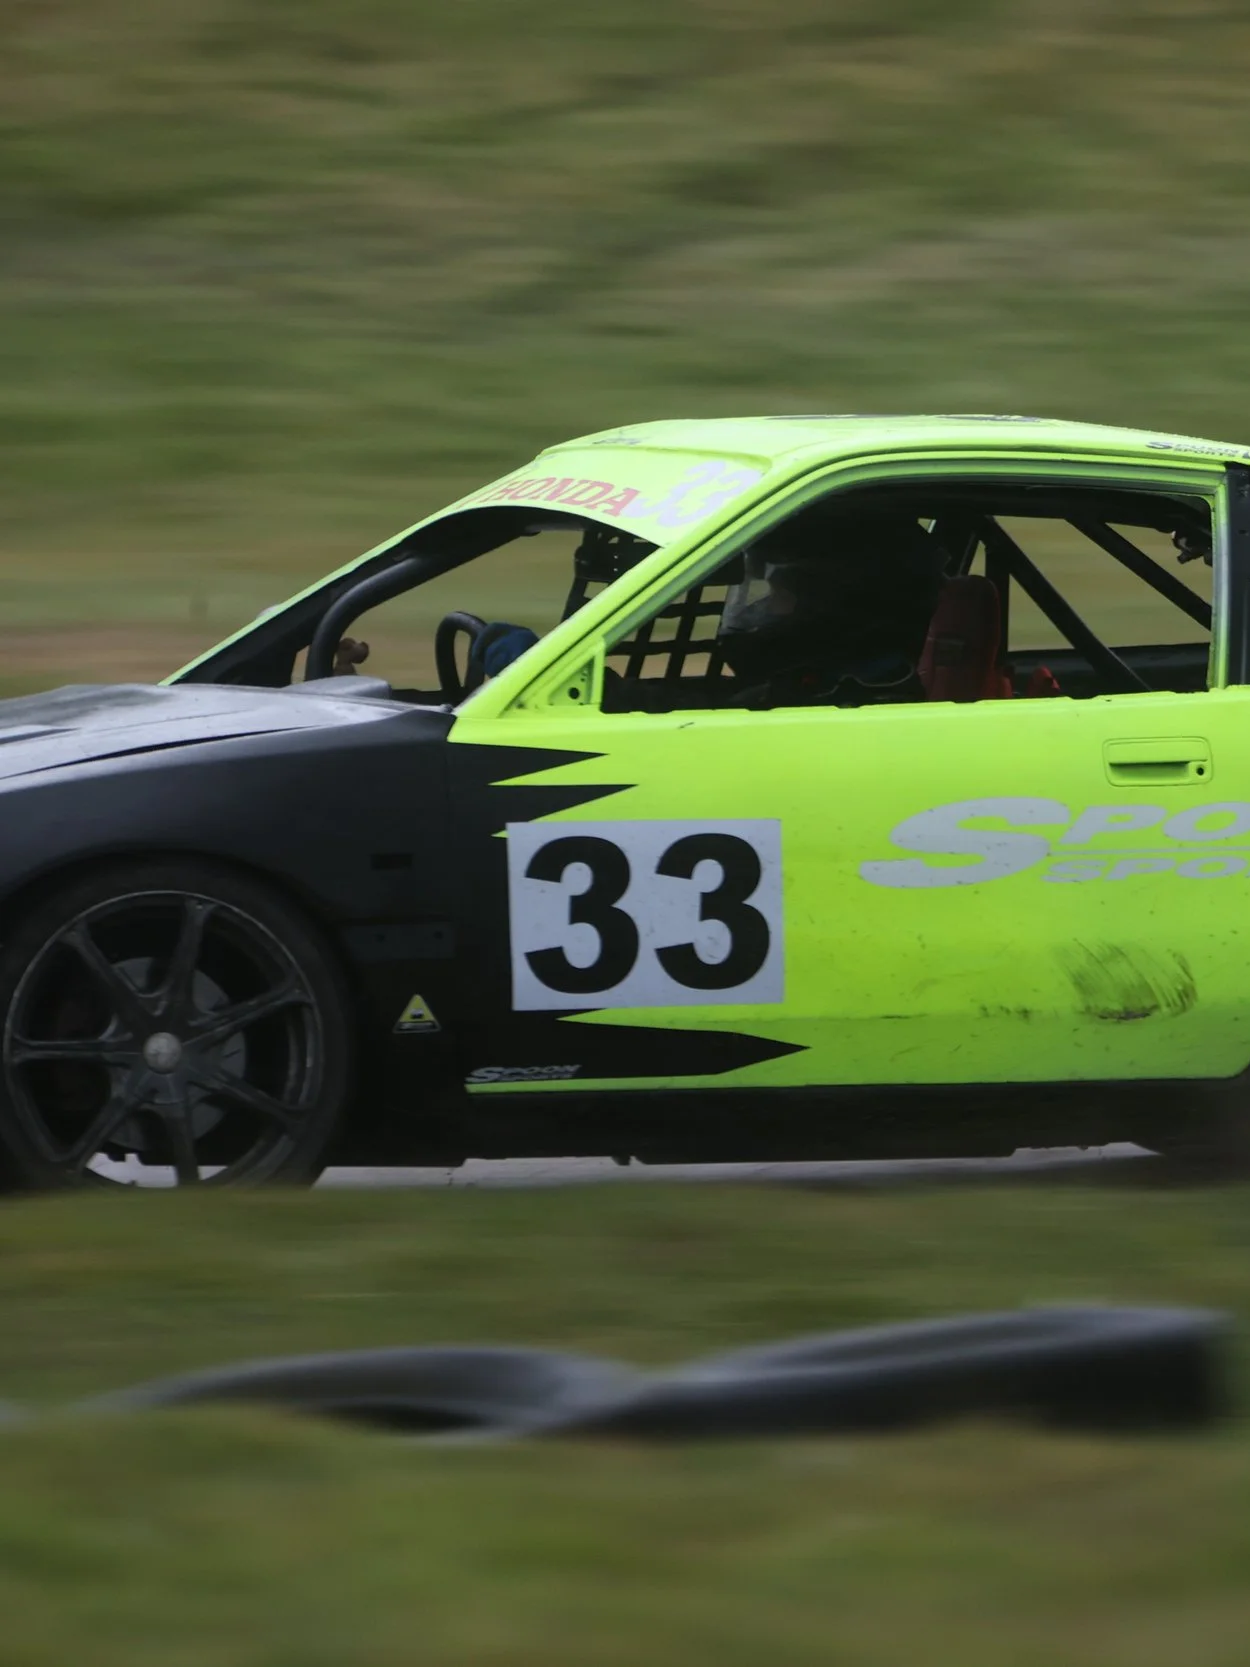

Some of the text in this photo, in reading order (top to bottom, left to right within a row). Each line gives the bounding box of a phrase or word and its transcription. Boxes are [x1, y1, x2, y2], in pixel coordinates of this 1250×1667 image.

[480, 476, 642, 518] HONDA
[622, 460, 763, 528] 33
[524, 833, 770, 994] 33
